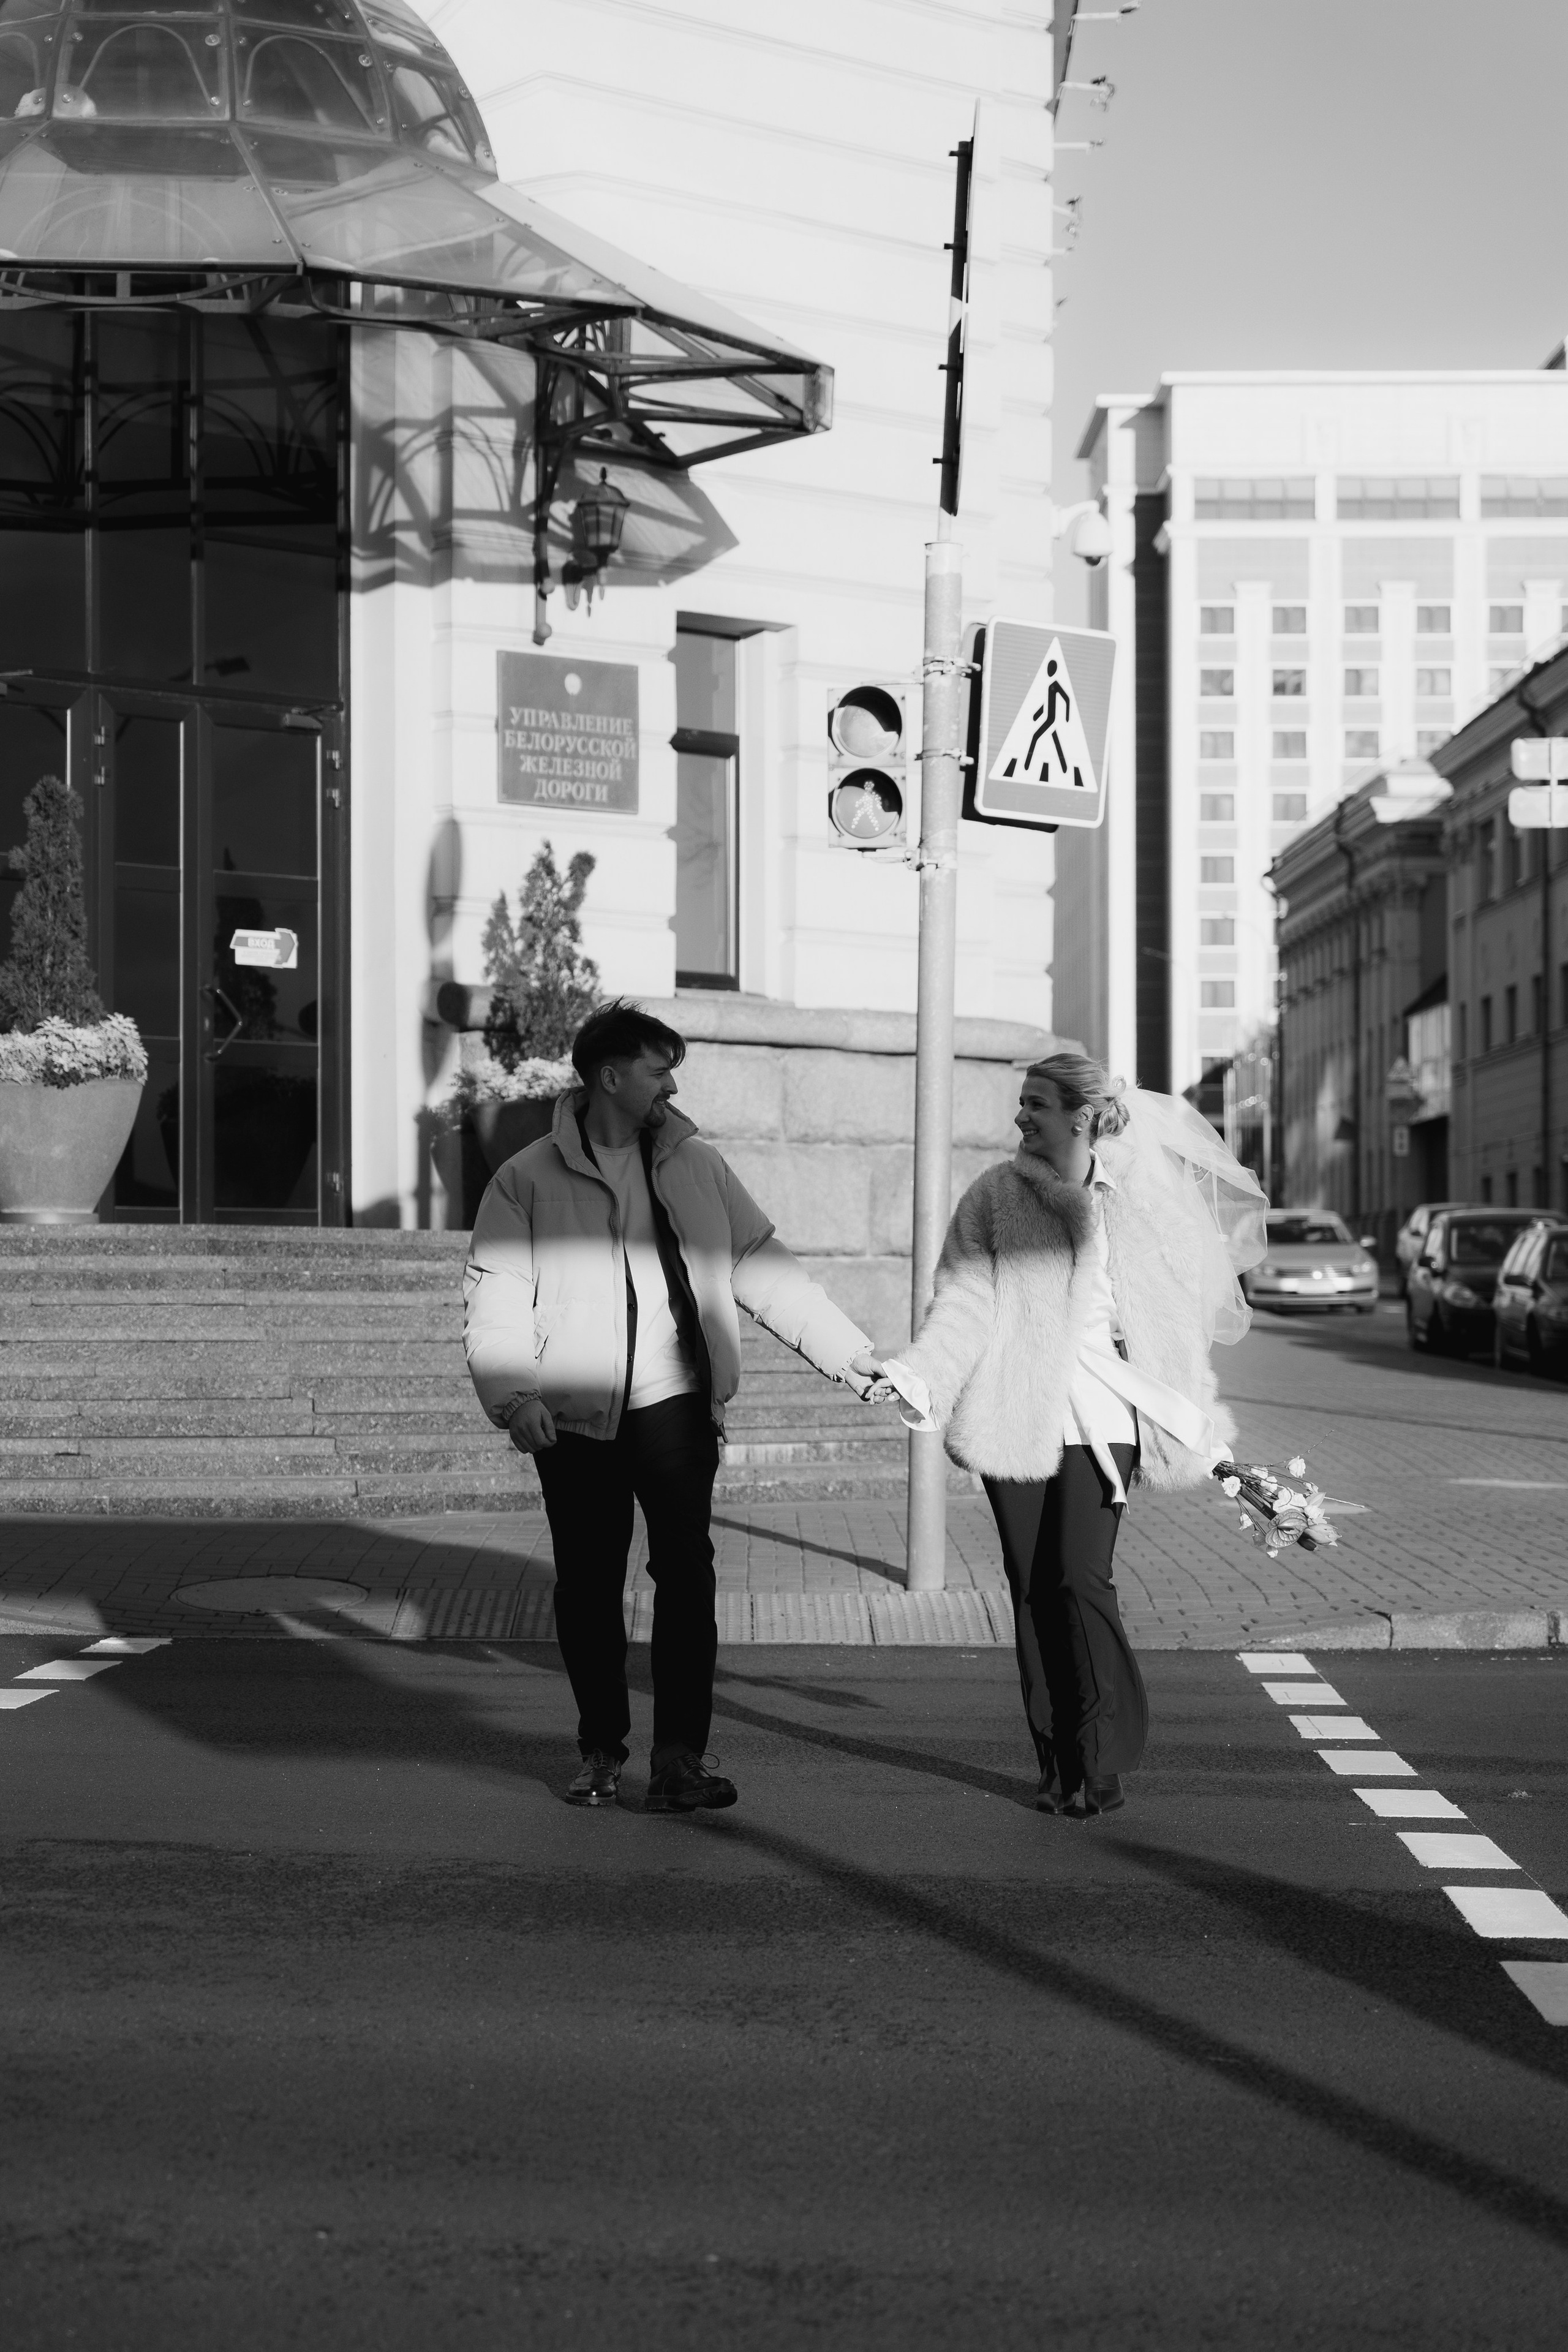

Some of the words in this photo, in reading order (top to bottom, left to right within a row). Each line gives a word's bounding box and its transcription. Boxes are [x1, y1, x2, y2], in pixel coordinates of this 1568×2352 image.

[509, 706, 633, 736] УПРАВЛЕНИЕ
[504, 729, 636, 760] БЕЛОРУССКОЙ
[519, 754, 622, 781] ЖЕЛЕЗНОЙ
[534, 778, 608, 803] ДОРОГИ
